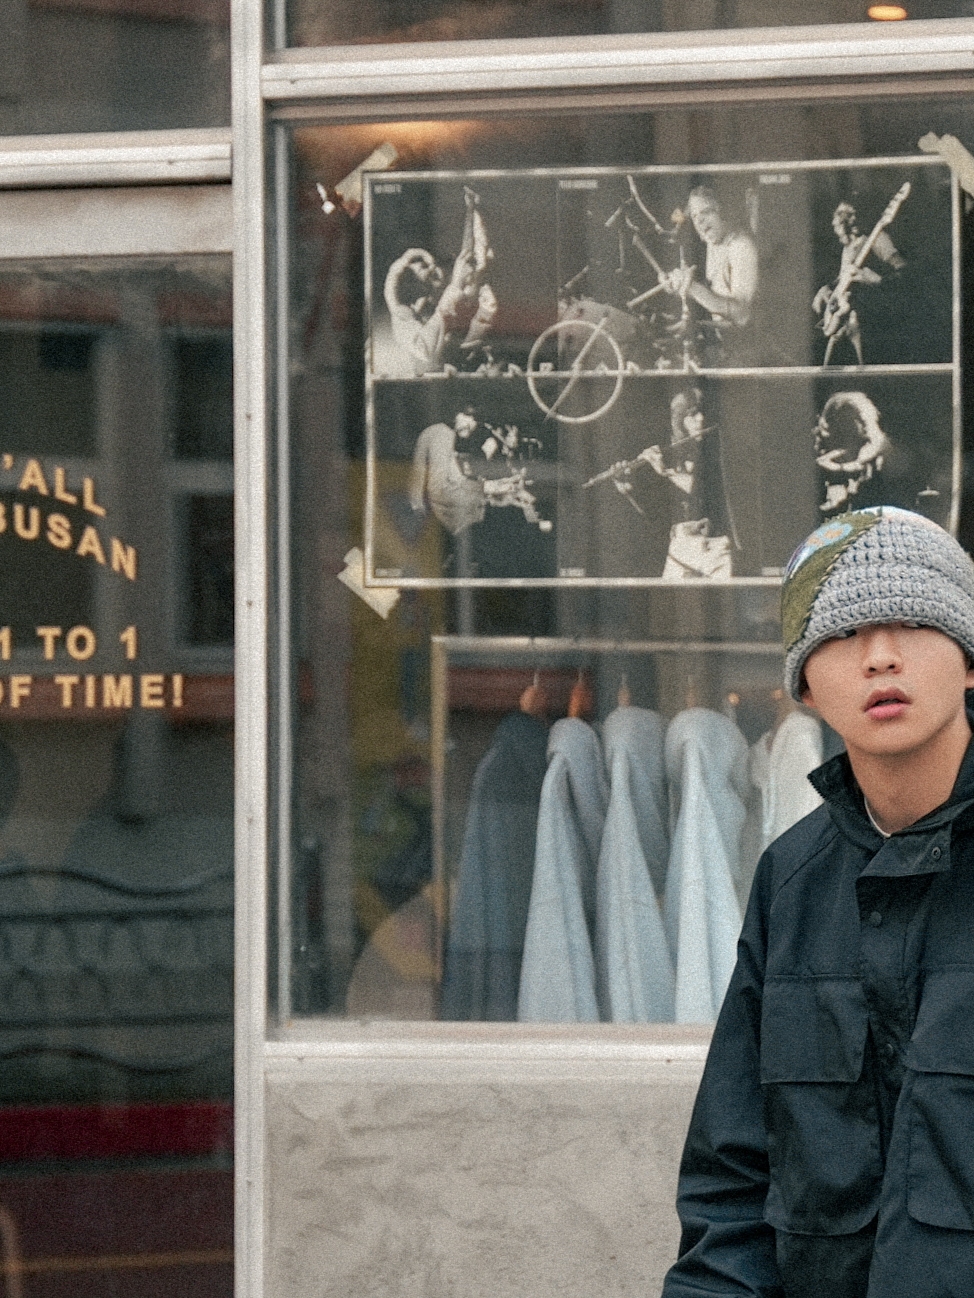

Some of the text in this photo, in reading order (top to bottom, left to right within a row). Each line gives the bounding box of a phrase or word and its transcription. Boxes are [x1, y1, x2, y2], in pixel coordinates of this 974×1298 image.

[0, 502, 137, 581] USAN
[37, 626, 97, 660] TO
[119, 625, 137, 660] 1
[0, 673, 184, 708] F TIME!
